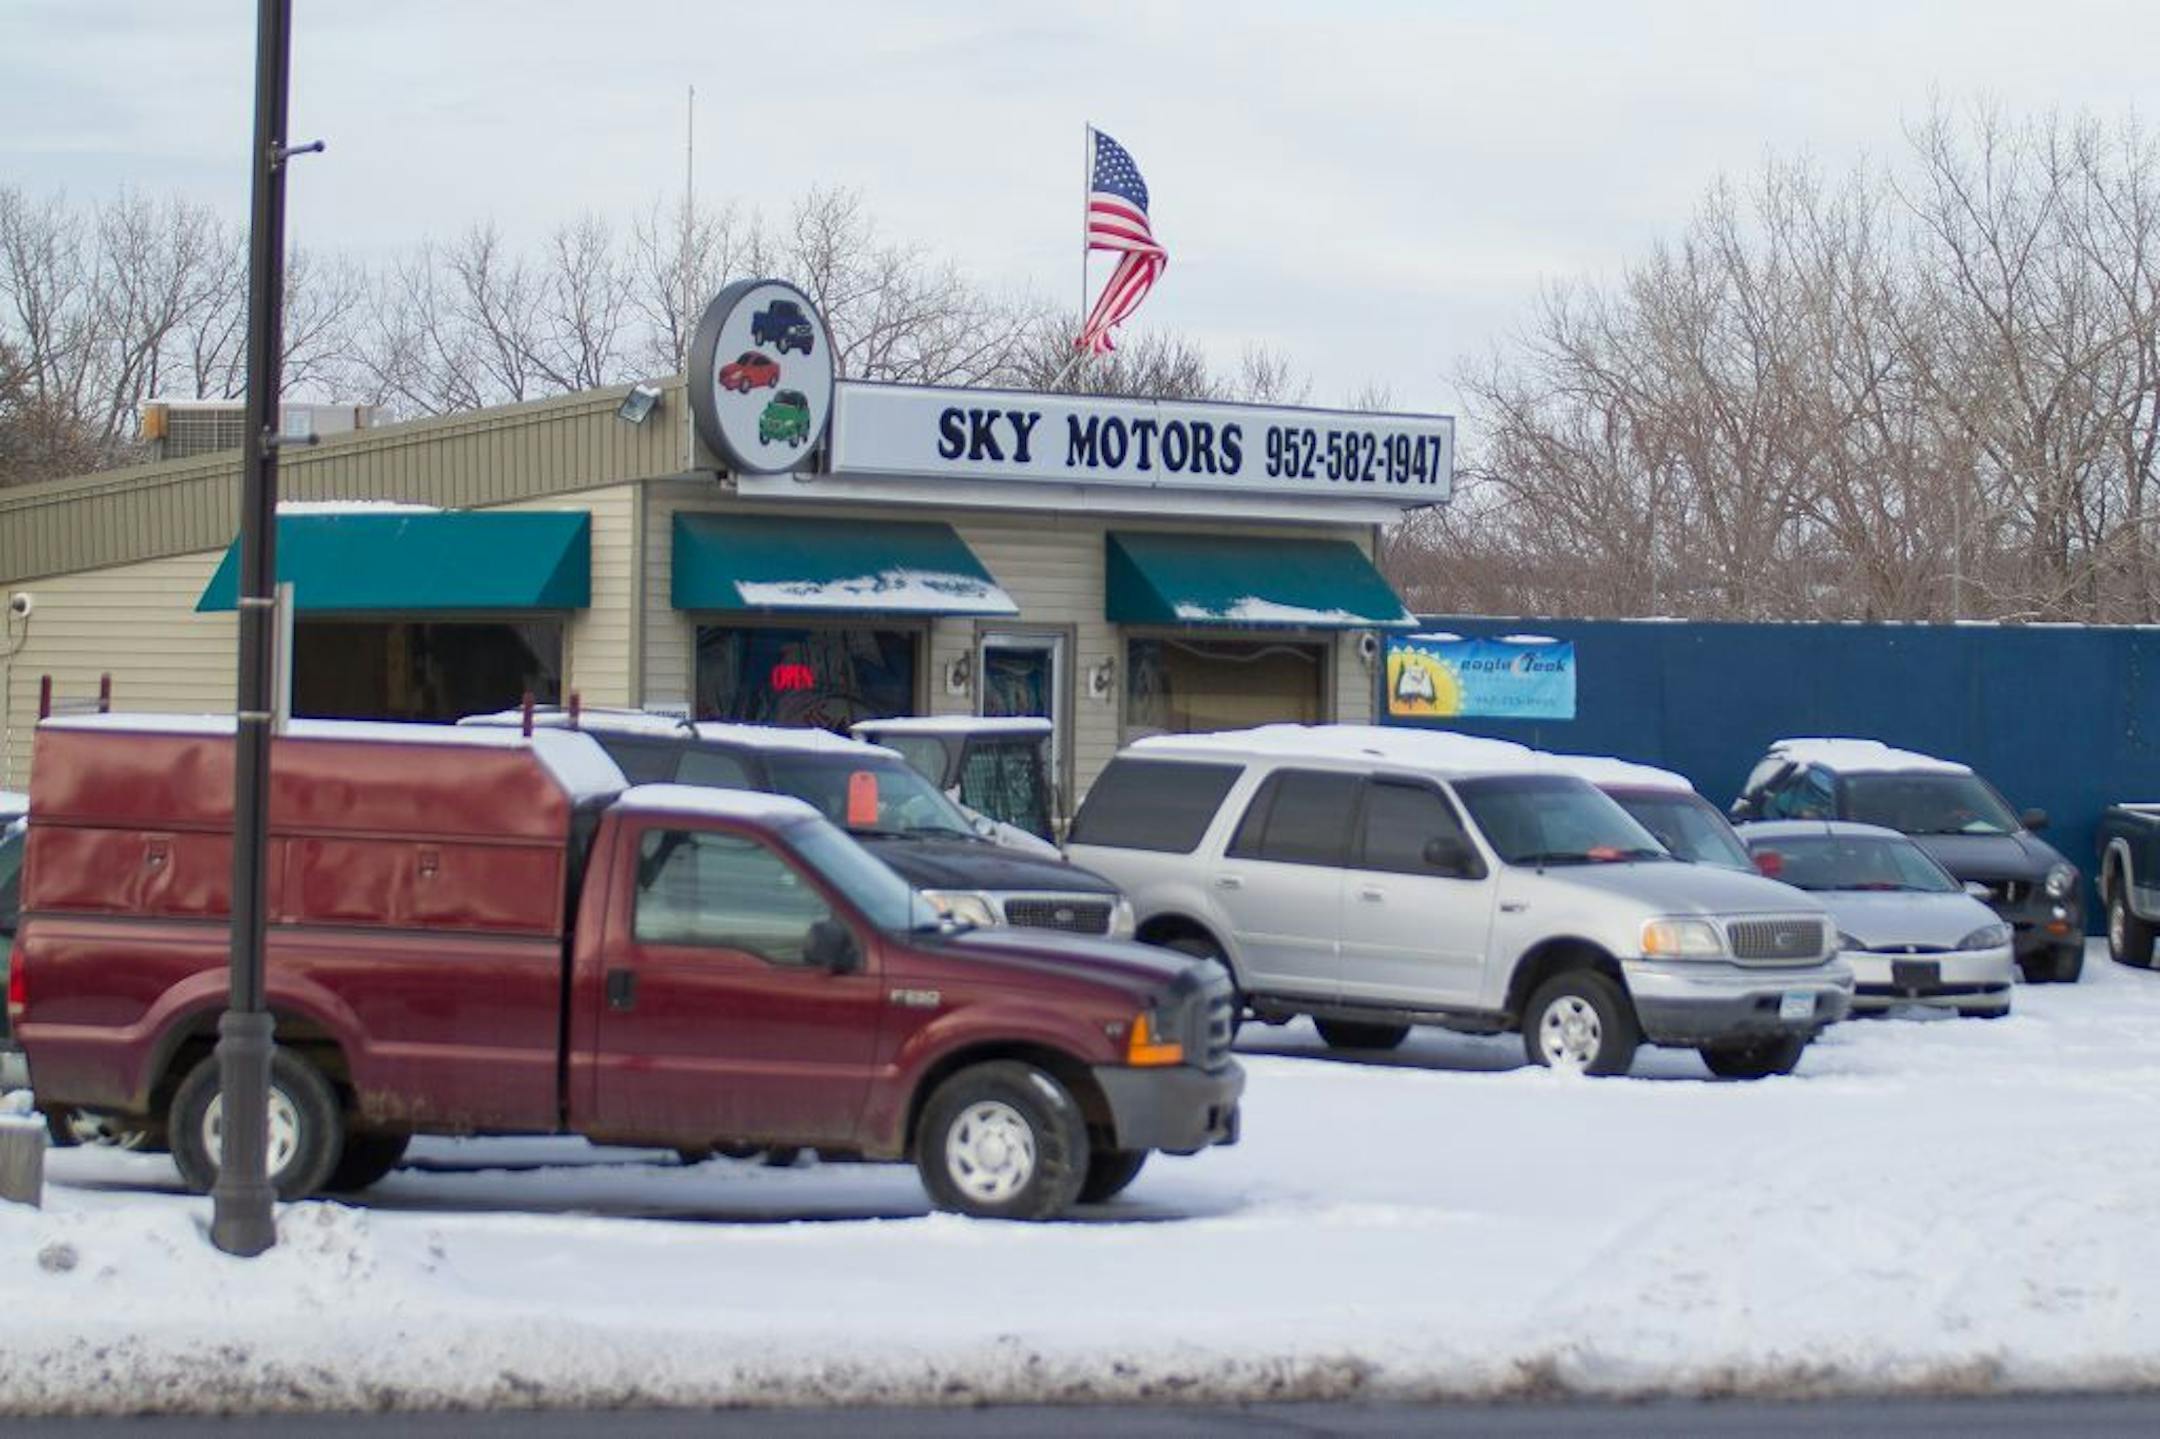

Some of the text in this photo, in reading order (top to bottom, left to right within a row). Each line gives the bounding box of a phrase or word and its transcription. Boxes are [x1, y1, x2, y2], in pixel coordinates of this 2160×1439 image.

[938, 406, 1442, 485] SKY MOTORS 952-582-1947
[771, 663, 814, 692] OPEN
